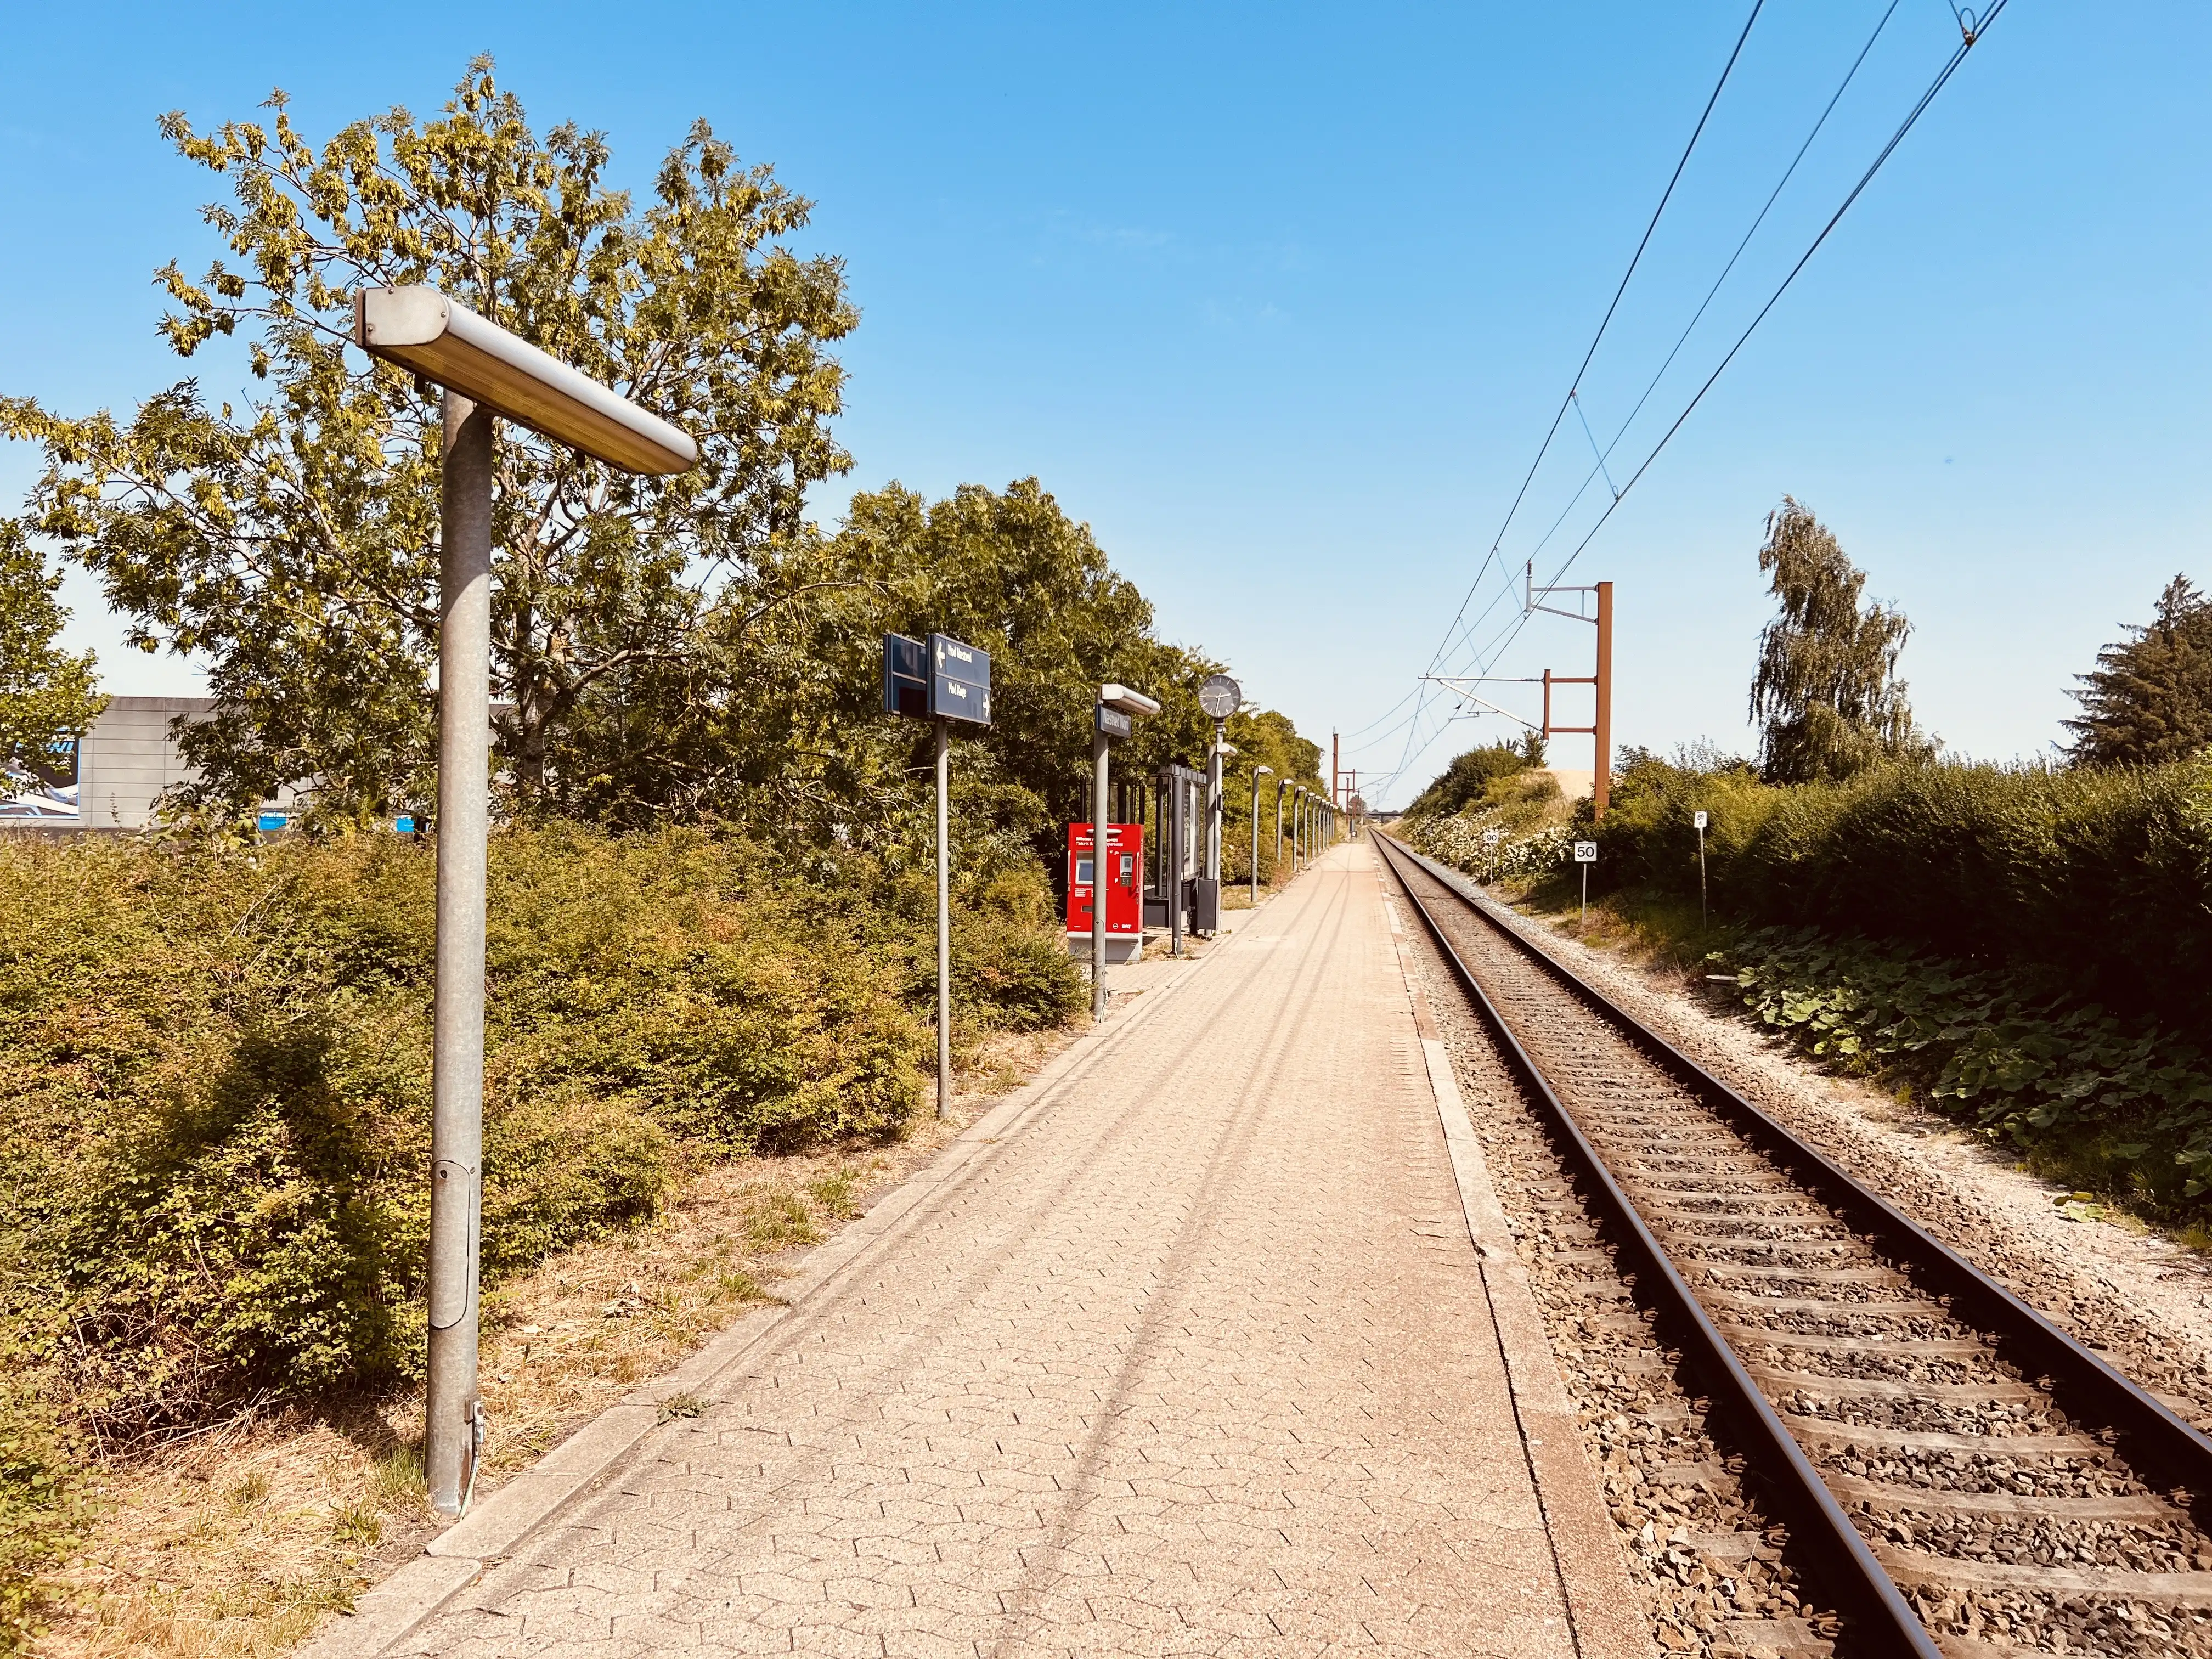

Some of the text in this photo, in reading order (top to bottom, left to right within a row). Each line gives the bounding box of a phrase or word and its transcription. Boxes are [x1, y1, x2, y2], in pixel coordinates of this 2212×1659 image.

[947, 643, 956, 658] Mod
[948, 682, 957, 695] Mod
[1577, 847, 1594, 857] 50
